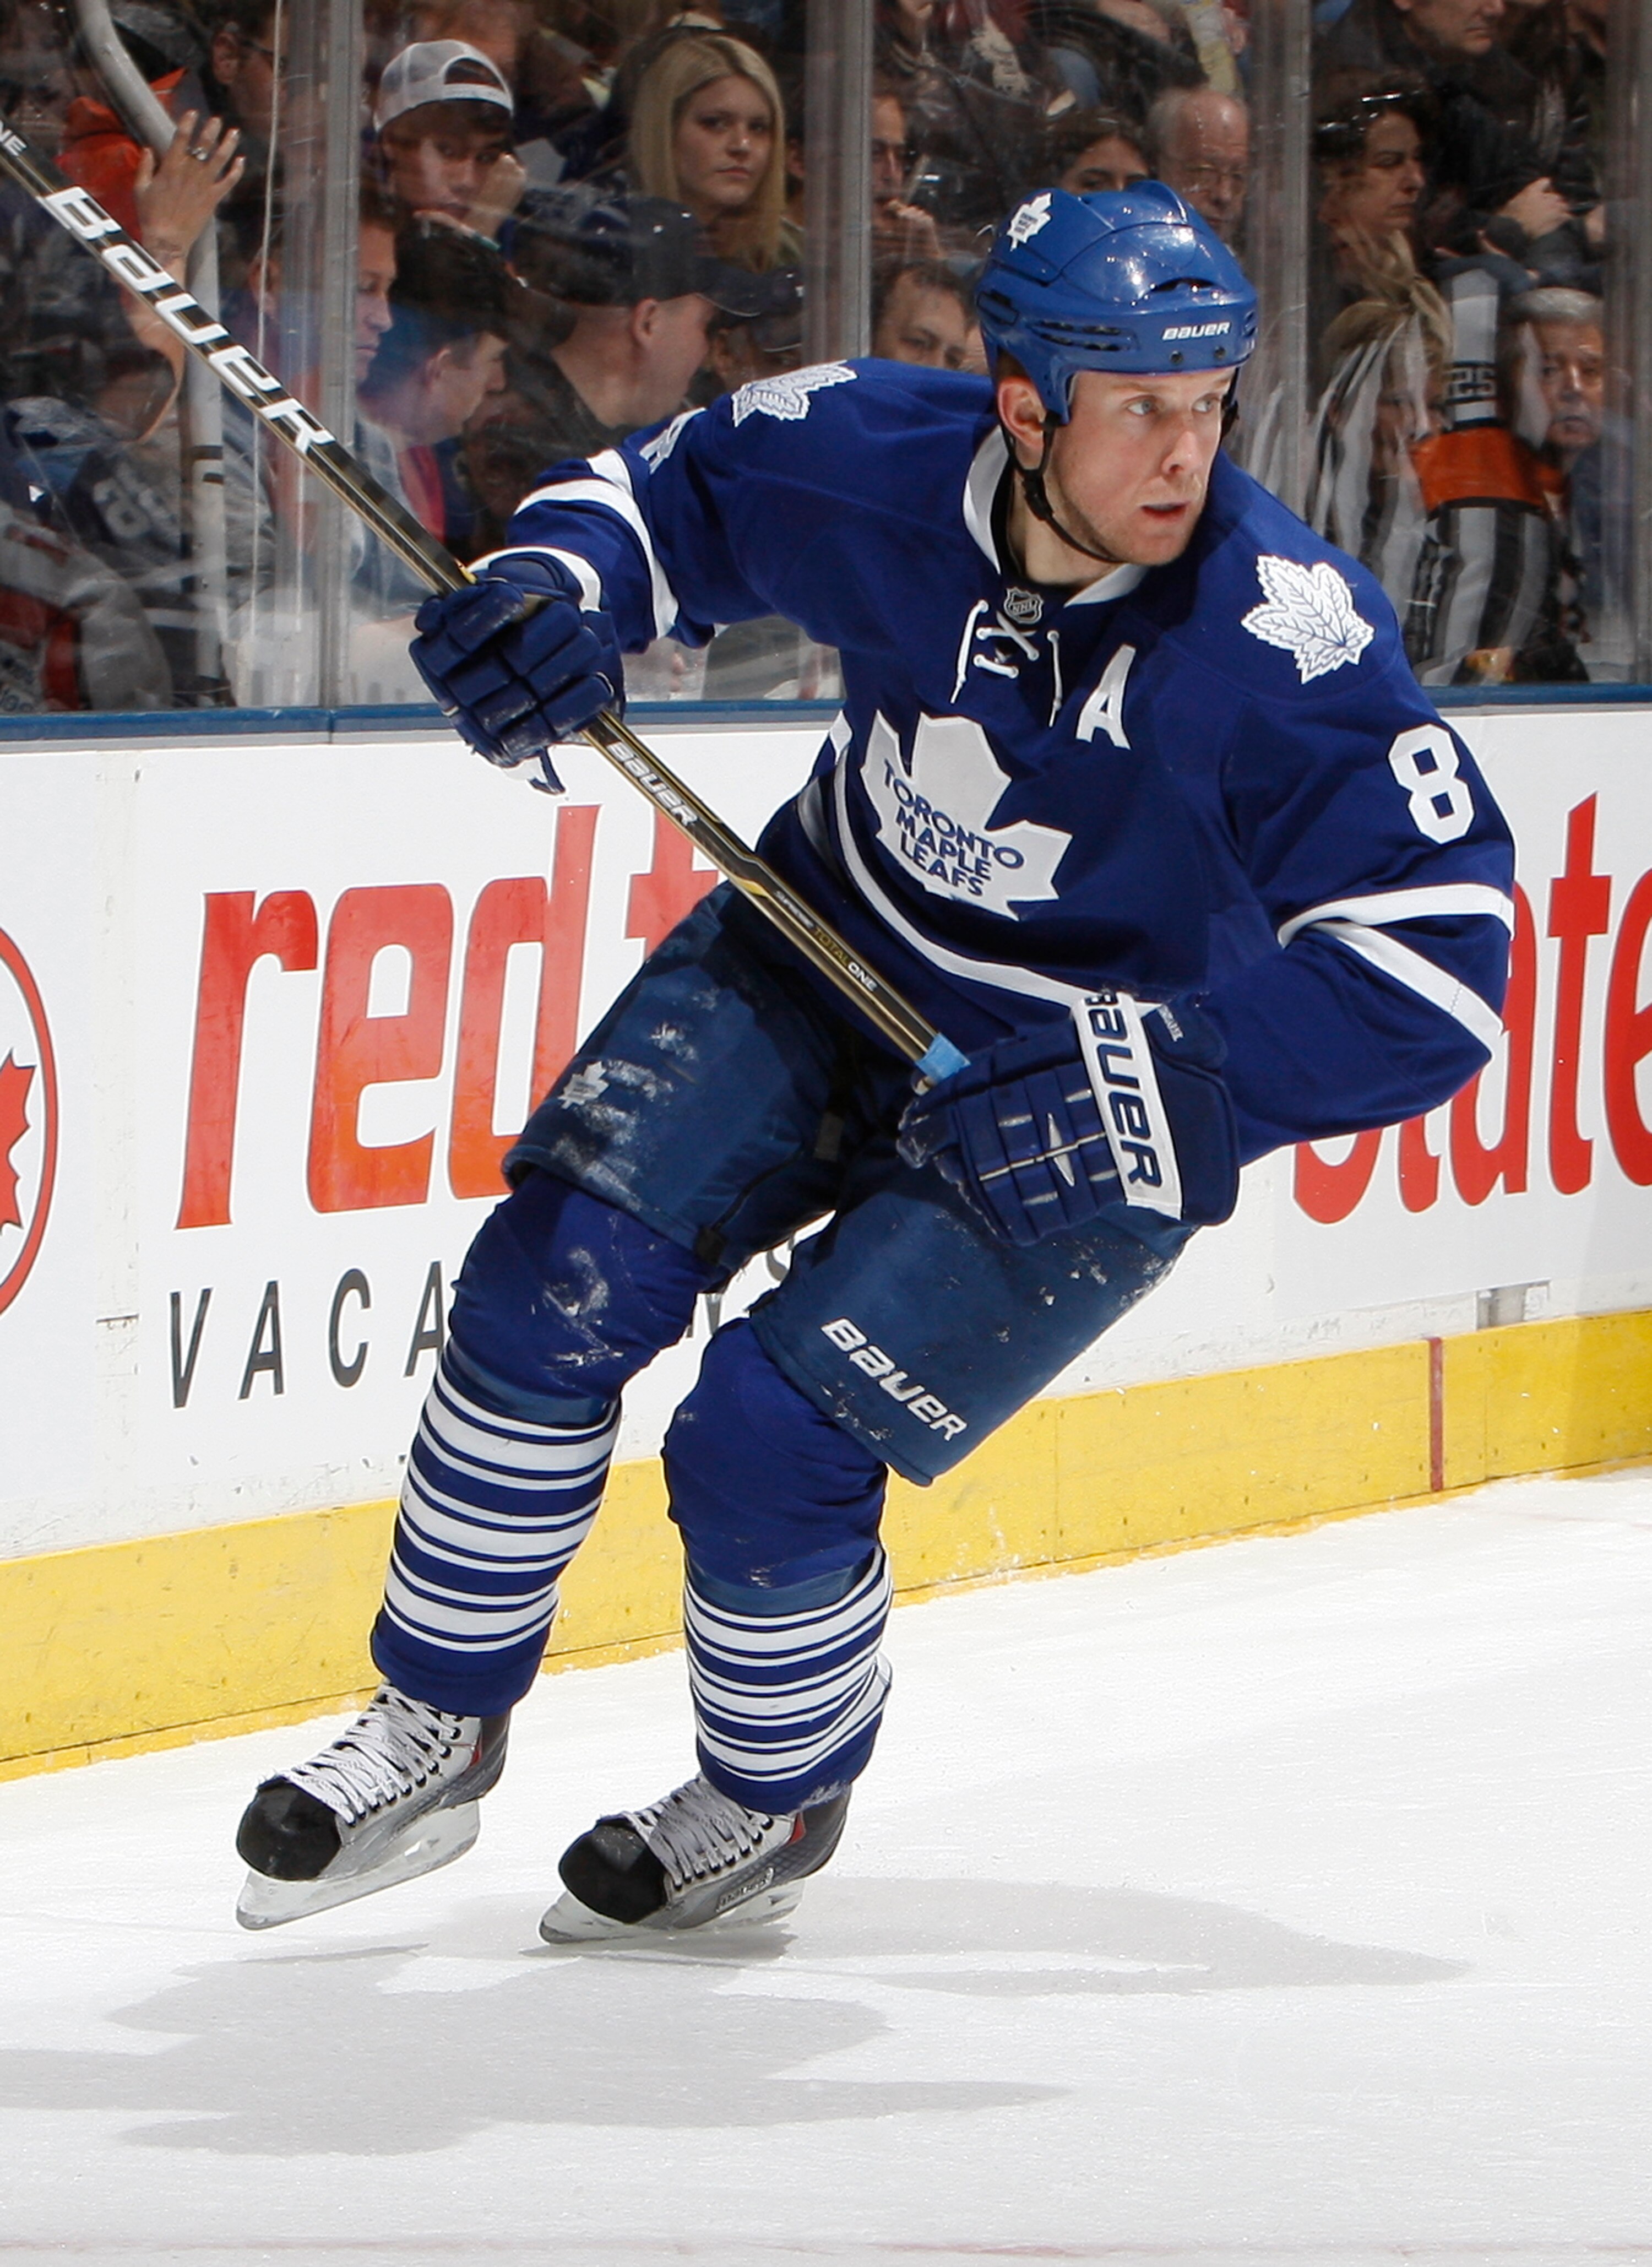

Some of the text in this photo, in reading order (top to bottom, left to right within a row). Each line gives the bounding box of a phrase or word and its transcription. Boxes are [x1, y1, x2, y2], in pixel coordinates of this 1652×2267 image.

[1162, 322, 1232, 341] BAUER
[1075, 643, 1137, 751] A
[606, 741, 698, 826] BAUER
[883, 758, 1025, 869] TORONTO
[1388, 723, 1475, 844] 8
[895, 808, 992, 881] MAPLE
[900, 833, 983, 897] LEAFS
[820, 1317, 968, 1441] BAUER
